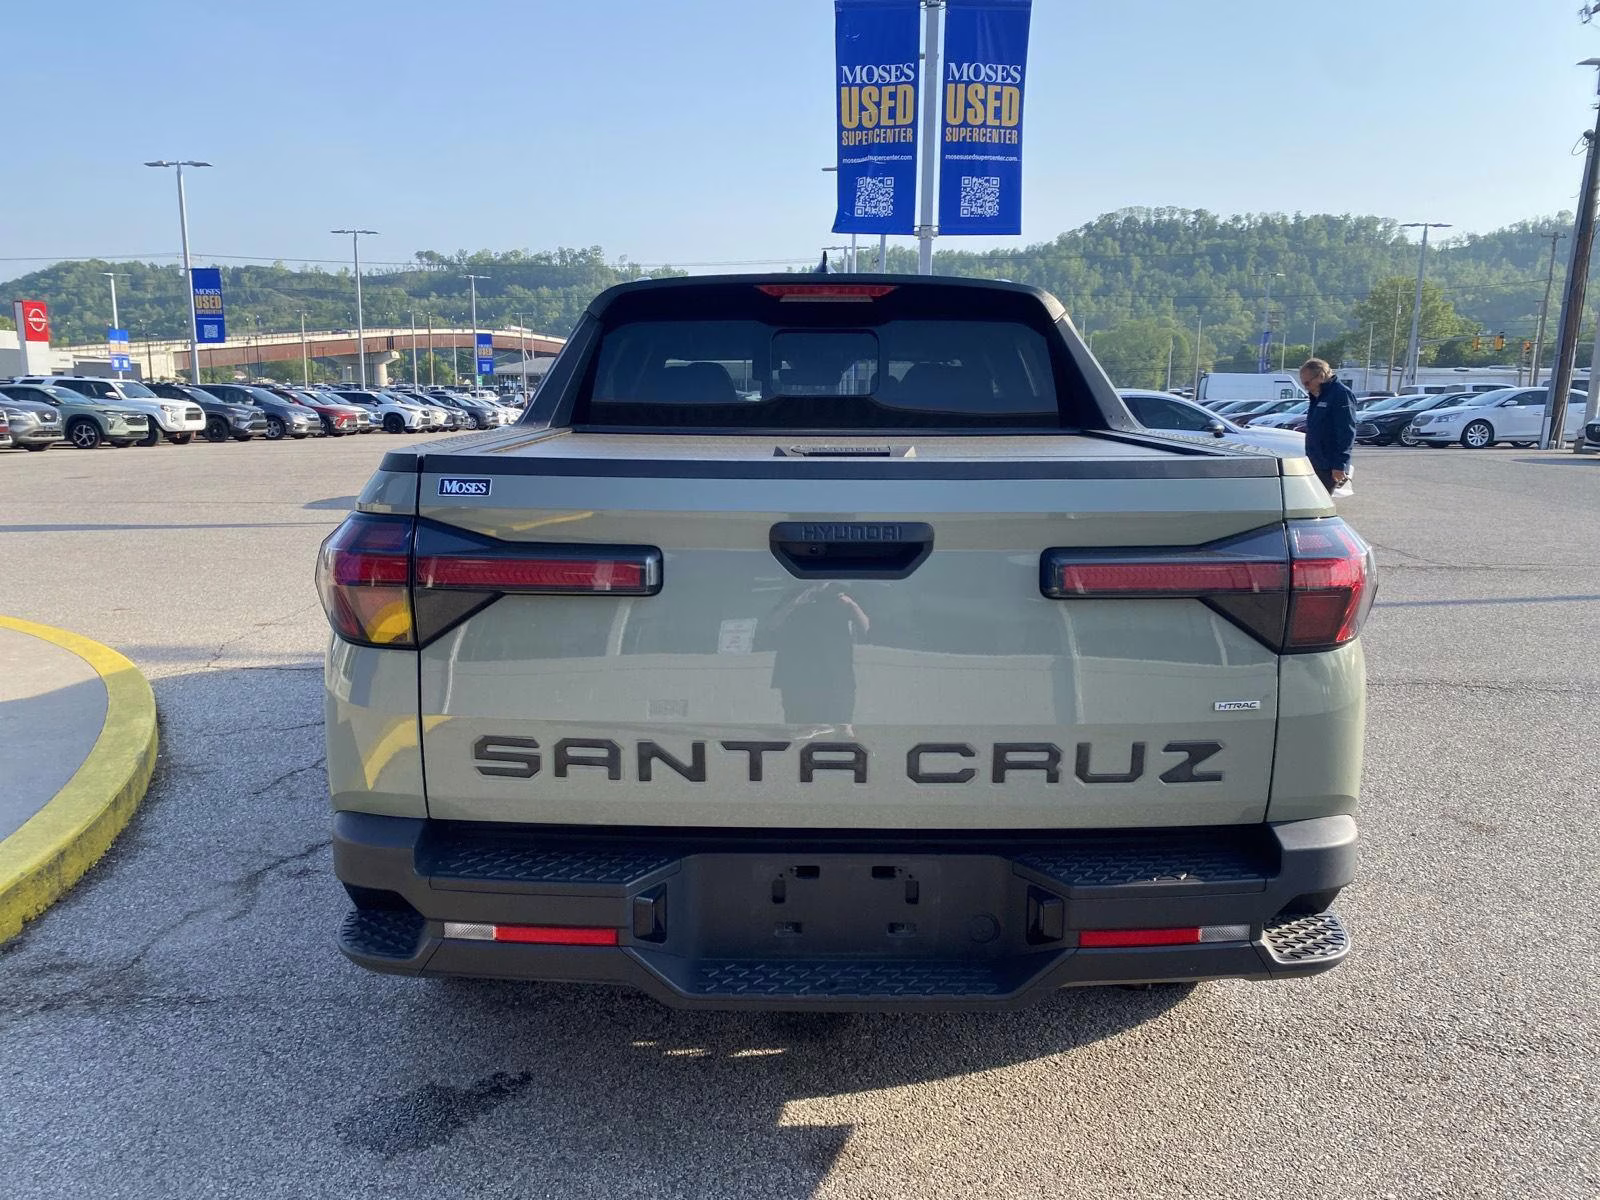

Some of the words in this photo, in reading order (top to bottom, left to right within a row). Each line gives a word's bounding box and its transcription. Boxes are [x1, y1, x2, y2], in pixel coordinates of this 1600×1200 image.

[841, 63, 915, 84] MOSES
[948, 62, 1021, 84] MOSES
[841, 84, 915, 129] USED
[946, 83, 1020, 127] USED
[842, 128, 913, 146] SUPERCENTER
[945, 127, 1018, 144] SUPERCENTER
[195, 295, 222, 309] USED
[801, 525, 902, 541] HYUNDAI
[474, 735, 868, 783] SANTA
[906, 740, 1223, 784] CRUZ
